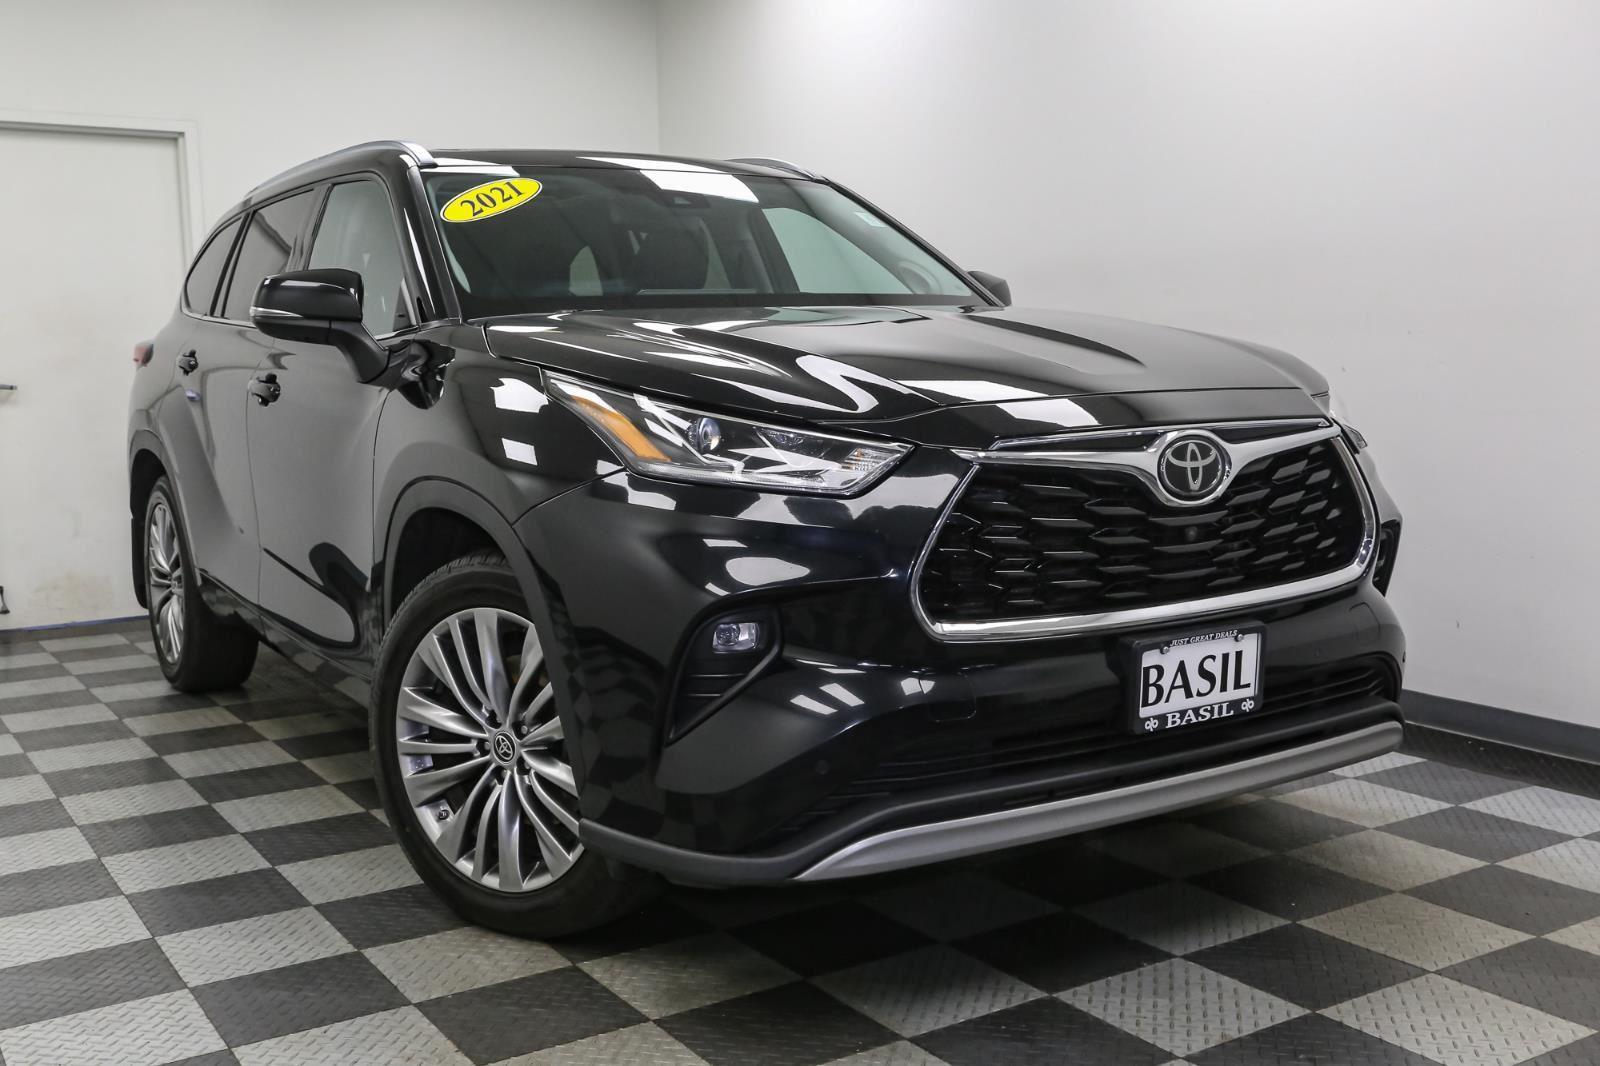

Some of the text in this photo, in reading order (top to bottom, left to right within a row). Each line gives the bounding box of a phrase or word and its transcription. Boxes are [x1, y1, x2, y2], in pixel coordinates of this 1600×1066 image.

[461, 182, 524, 216] 2021
[1170, 629, 1238, 647] JUST GREAT DEALS
[1141, 650, 1251, 708] BASIL
[1165, 703, 1234, 728] BASIL
